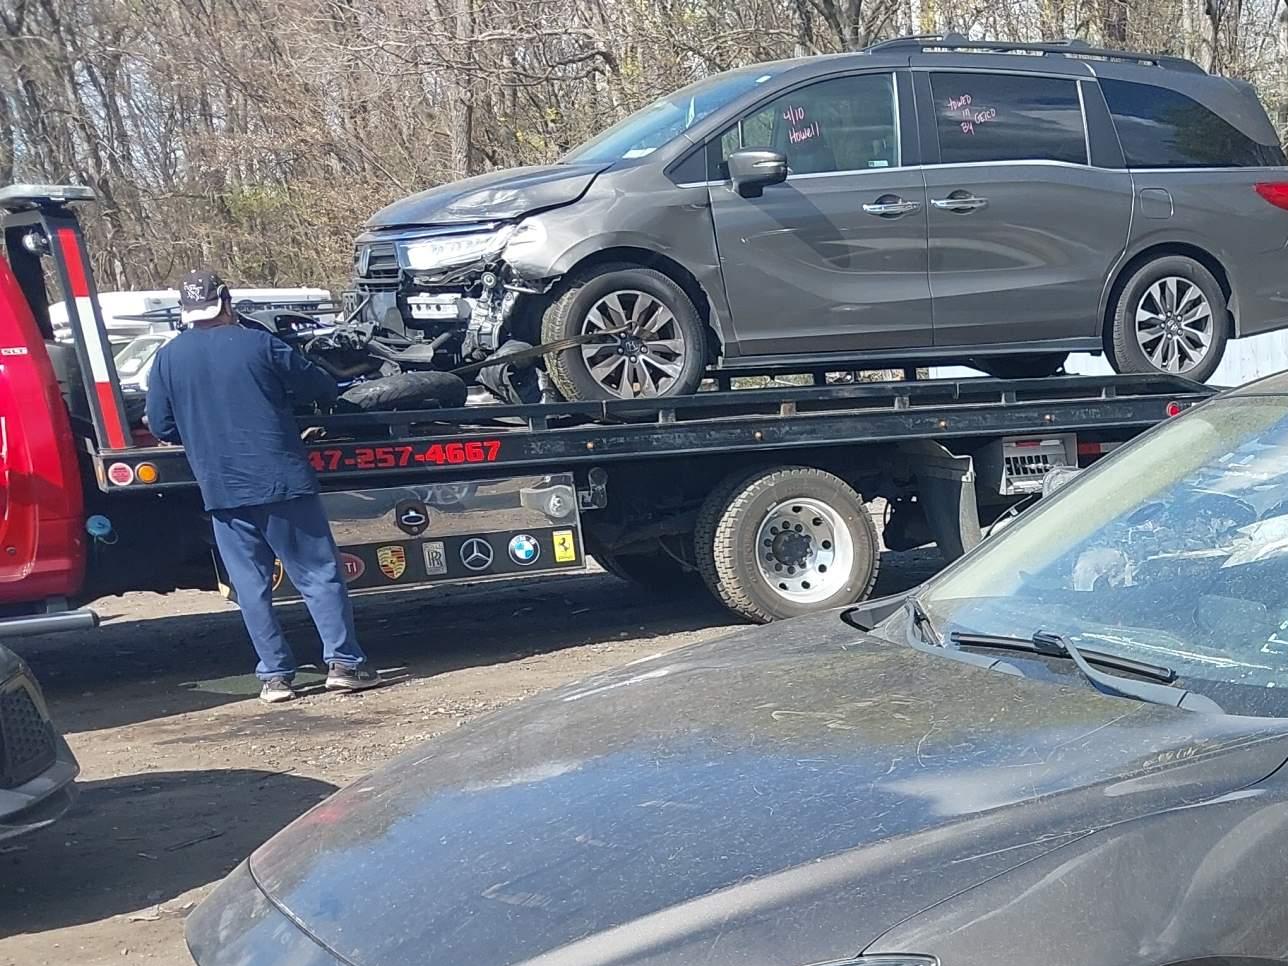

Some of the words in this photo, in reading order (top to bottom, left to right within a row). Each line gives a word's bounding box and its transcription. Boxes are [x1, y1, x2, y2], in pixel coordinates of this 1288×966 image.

[783, 104, 805, 126] 4/10
[974, 108, 996, 124] GEICO
[789, 120, 820, 144] Howell
[308, 440, 501, 472] 47-257-4667
